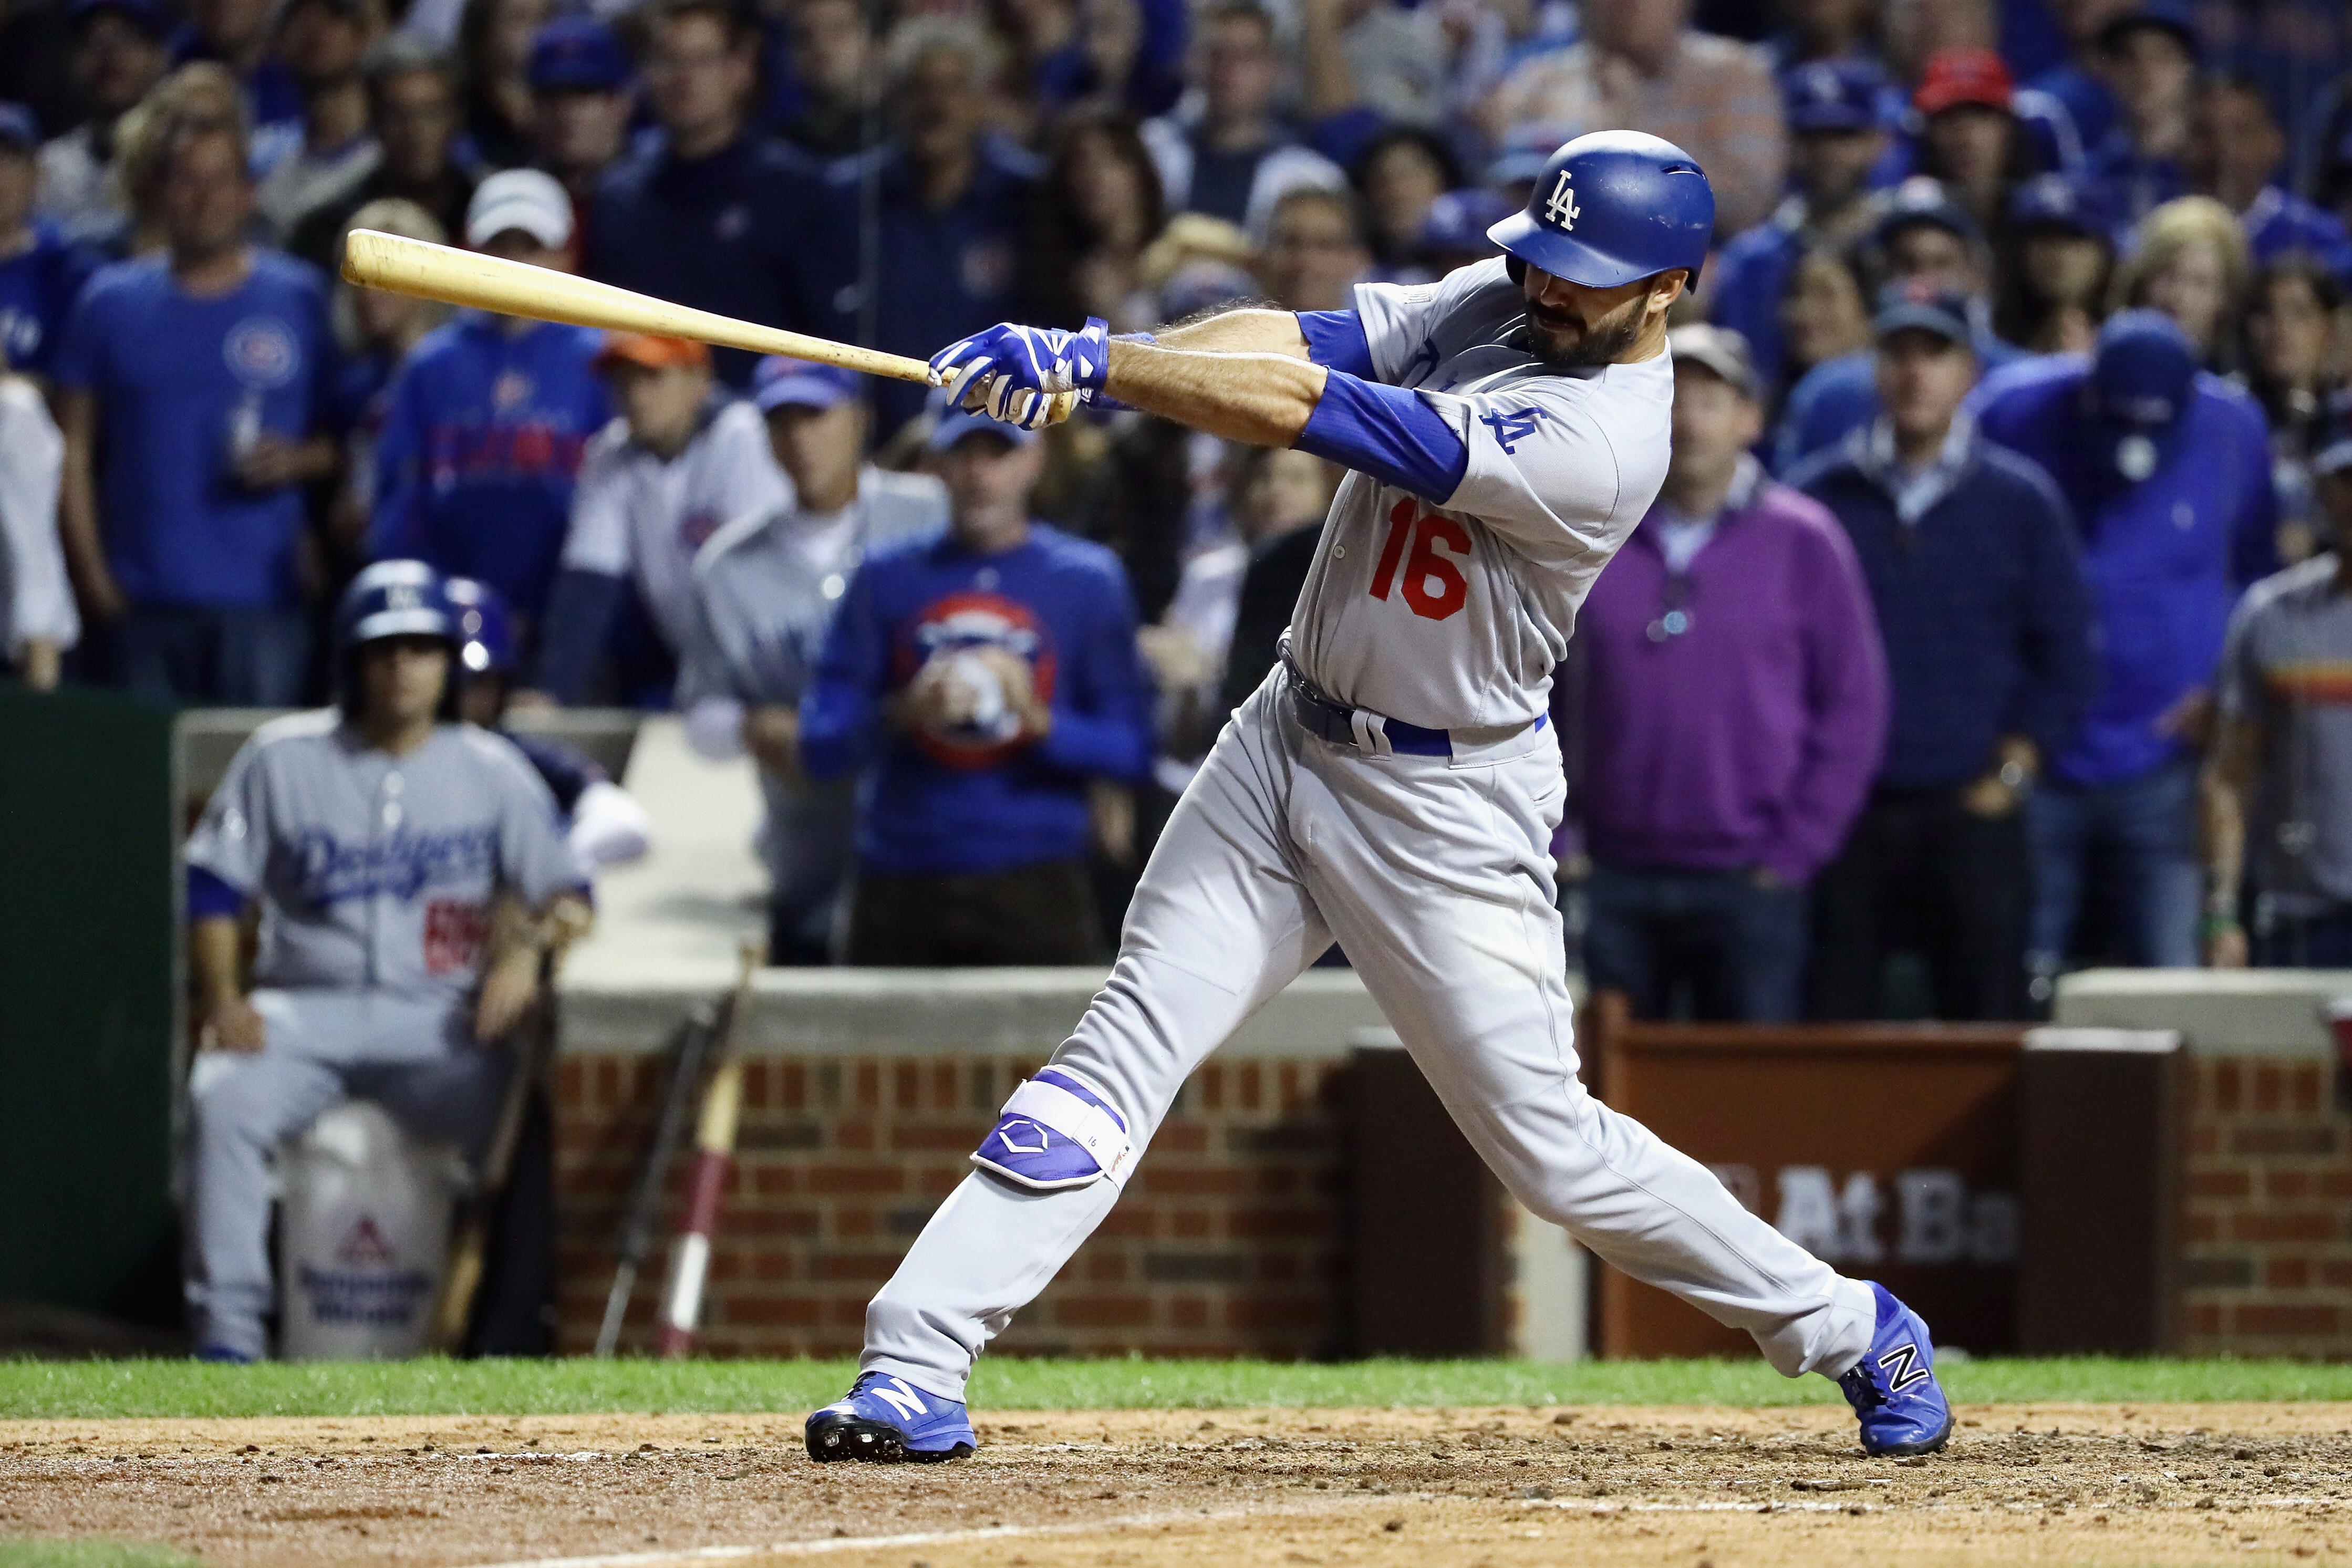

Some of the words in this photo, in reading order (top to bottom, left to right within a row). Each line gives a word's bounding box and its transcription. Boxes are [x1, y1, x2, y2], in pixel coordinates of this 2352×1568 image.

[1545, 170, 1580, 231] LA
[1479, 407, 1547, 455] LA
[1369, 496, 1472, 621] 16
[1088, 1136, 1096, 1147] 16
[1774, 1164, 1887, 1262] At
[1878, 1344, 1930, 1393] N
[871, 1377, 928, 1421] N
